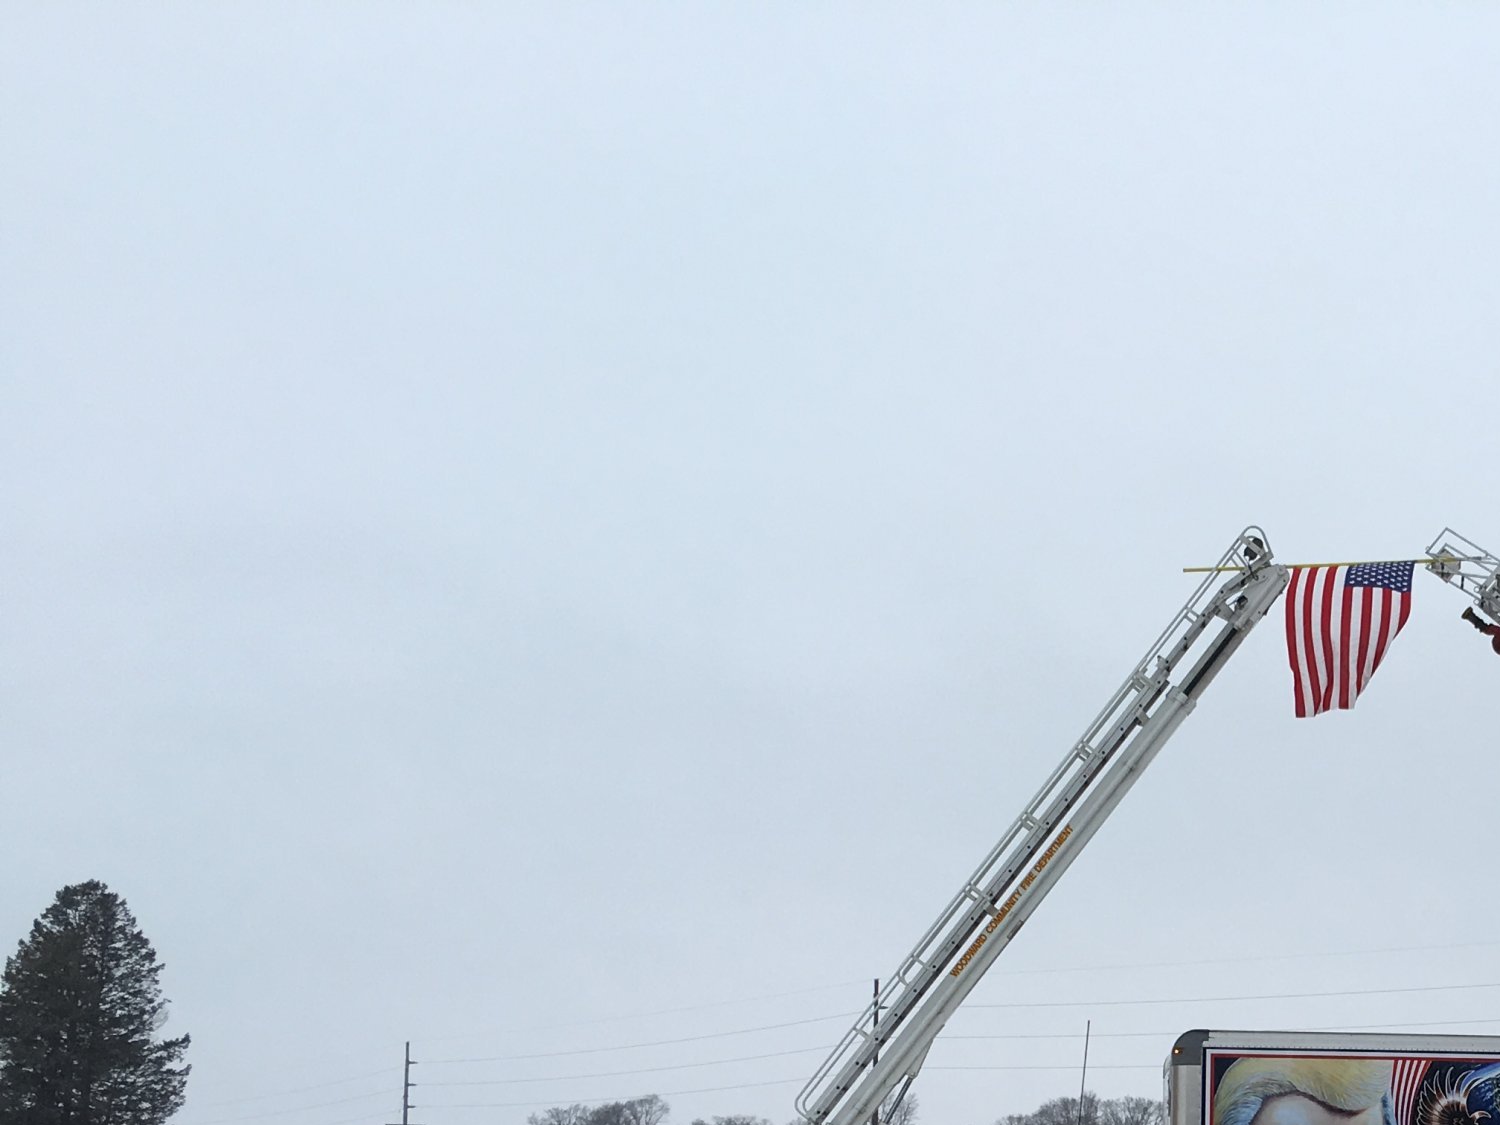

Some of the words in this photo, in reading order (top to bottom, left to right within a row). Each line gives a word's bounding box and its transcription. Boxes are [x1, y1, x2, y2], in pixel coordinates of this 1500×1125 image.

[949, 933, 987, 977] WOODWARD
[985, 889, 1023, 934] COMMUNITY
[1020, 873, 1037, 891] FIRE
[1034, 824, 1074, 873] DEPARTMENT
